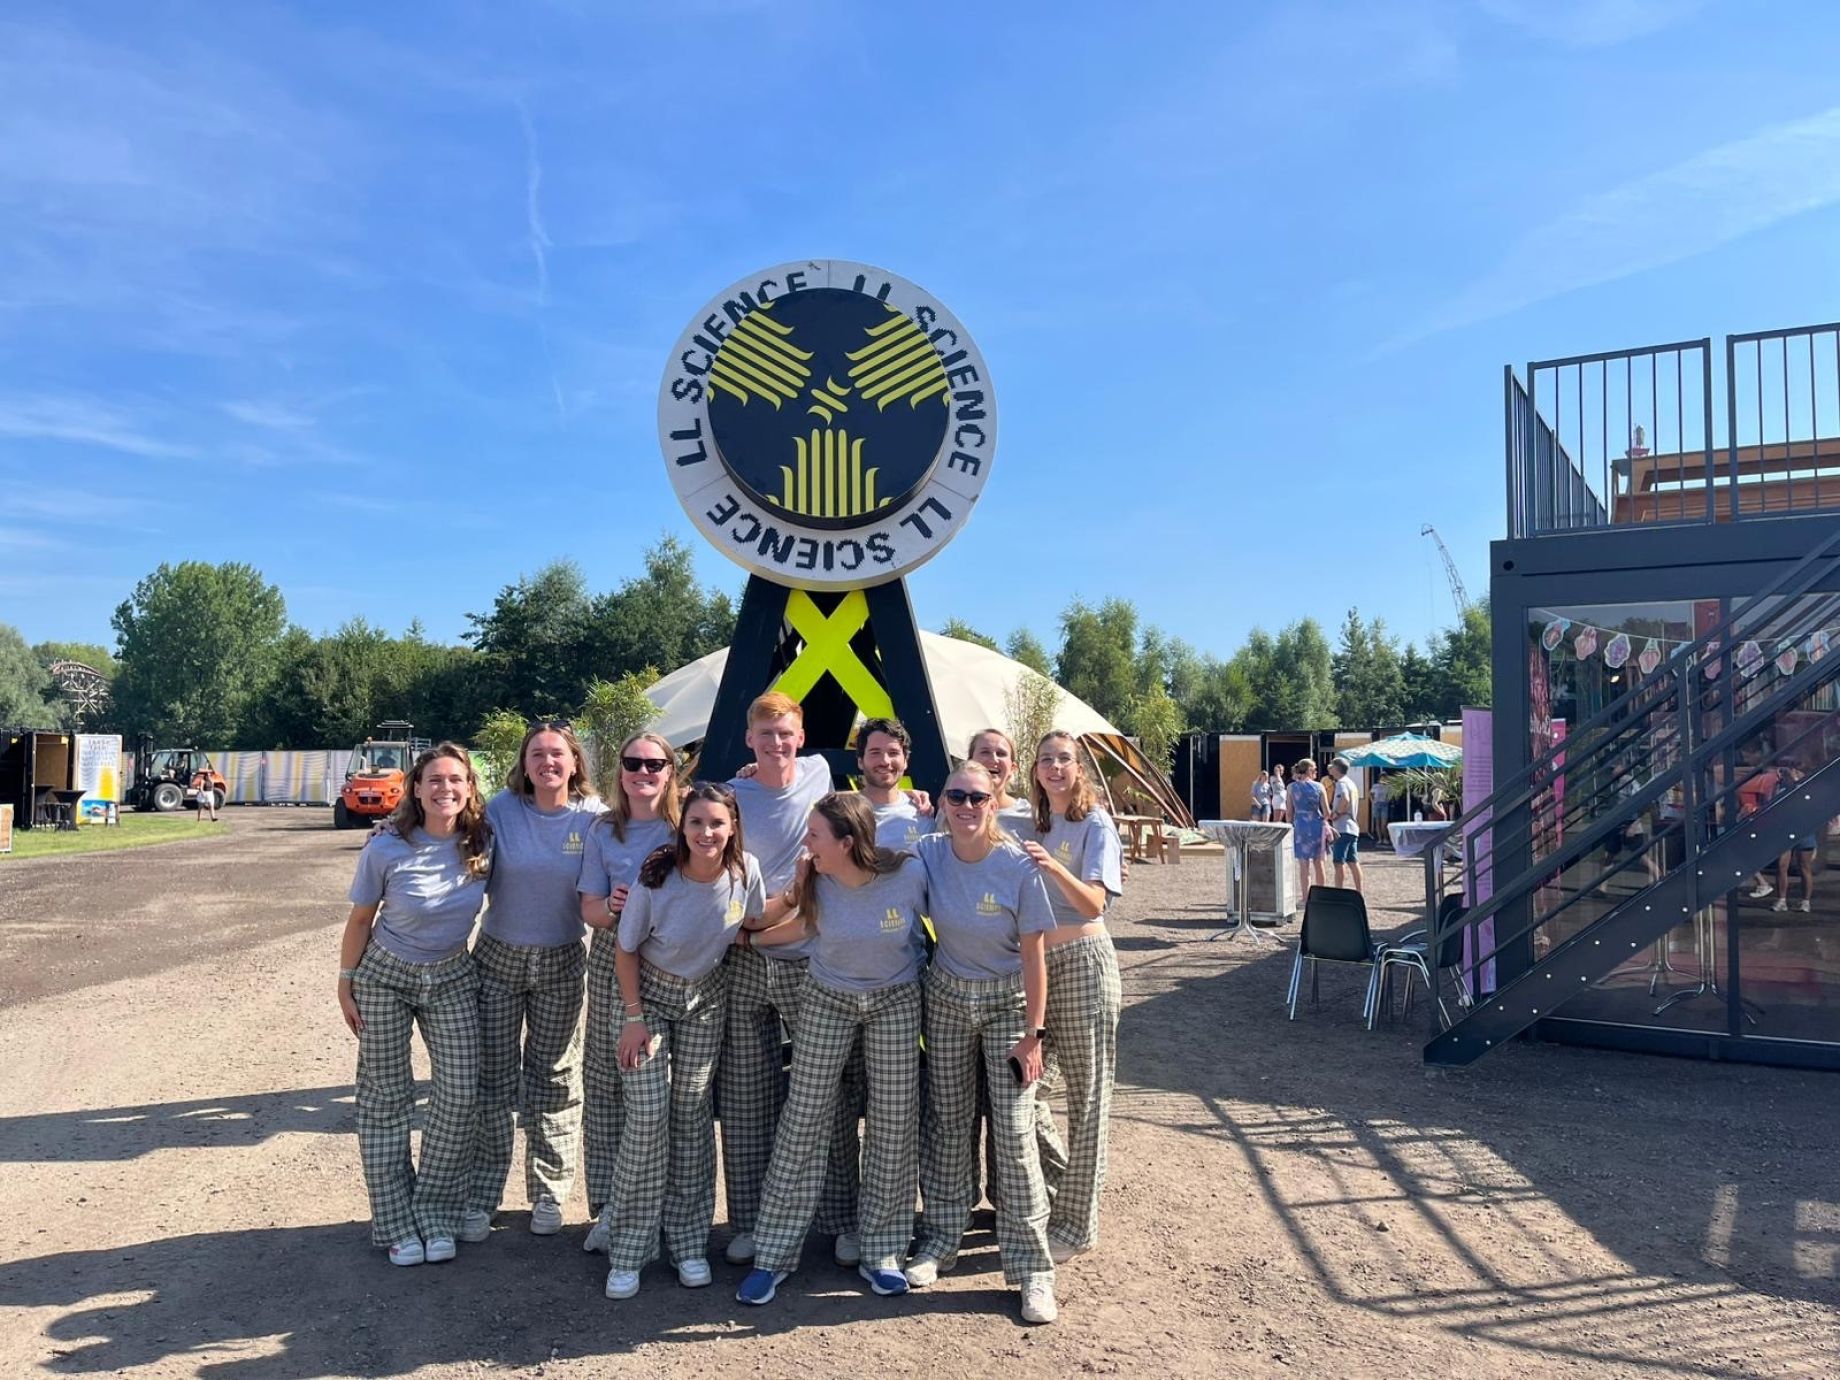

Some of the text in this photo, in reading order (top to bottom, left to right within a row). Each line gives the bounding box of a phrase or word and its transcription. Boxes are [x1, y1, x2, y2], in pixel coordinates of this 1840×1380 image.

[670, 271, 808, 467] LL SCIENCE
[916, 305, 987, 478] SCIENCE
[706, 494, 952, 571] LL SCIENCE
